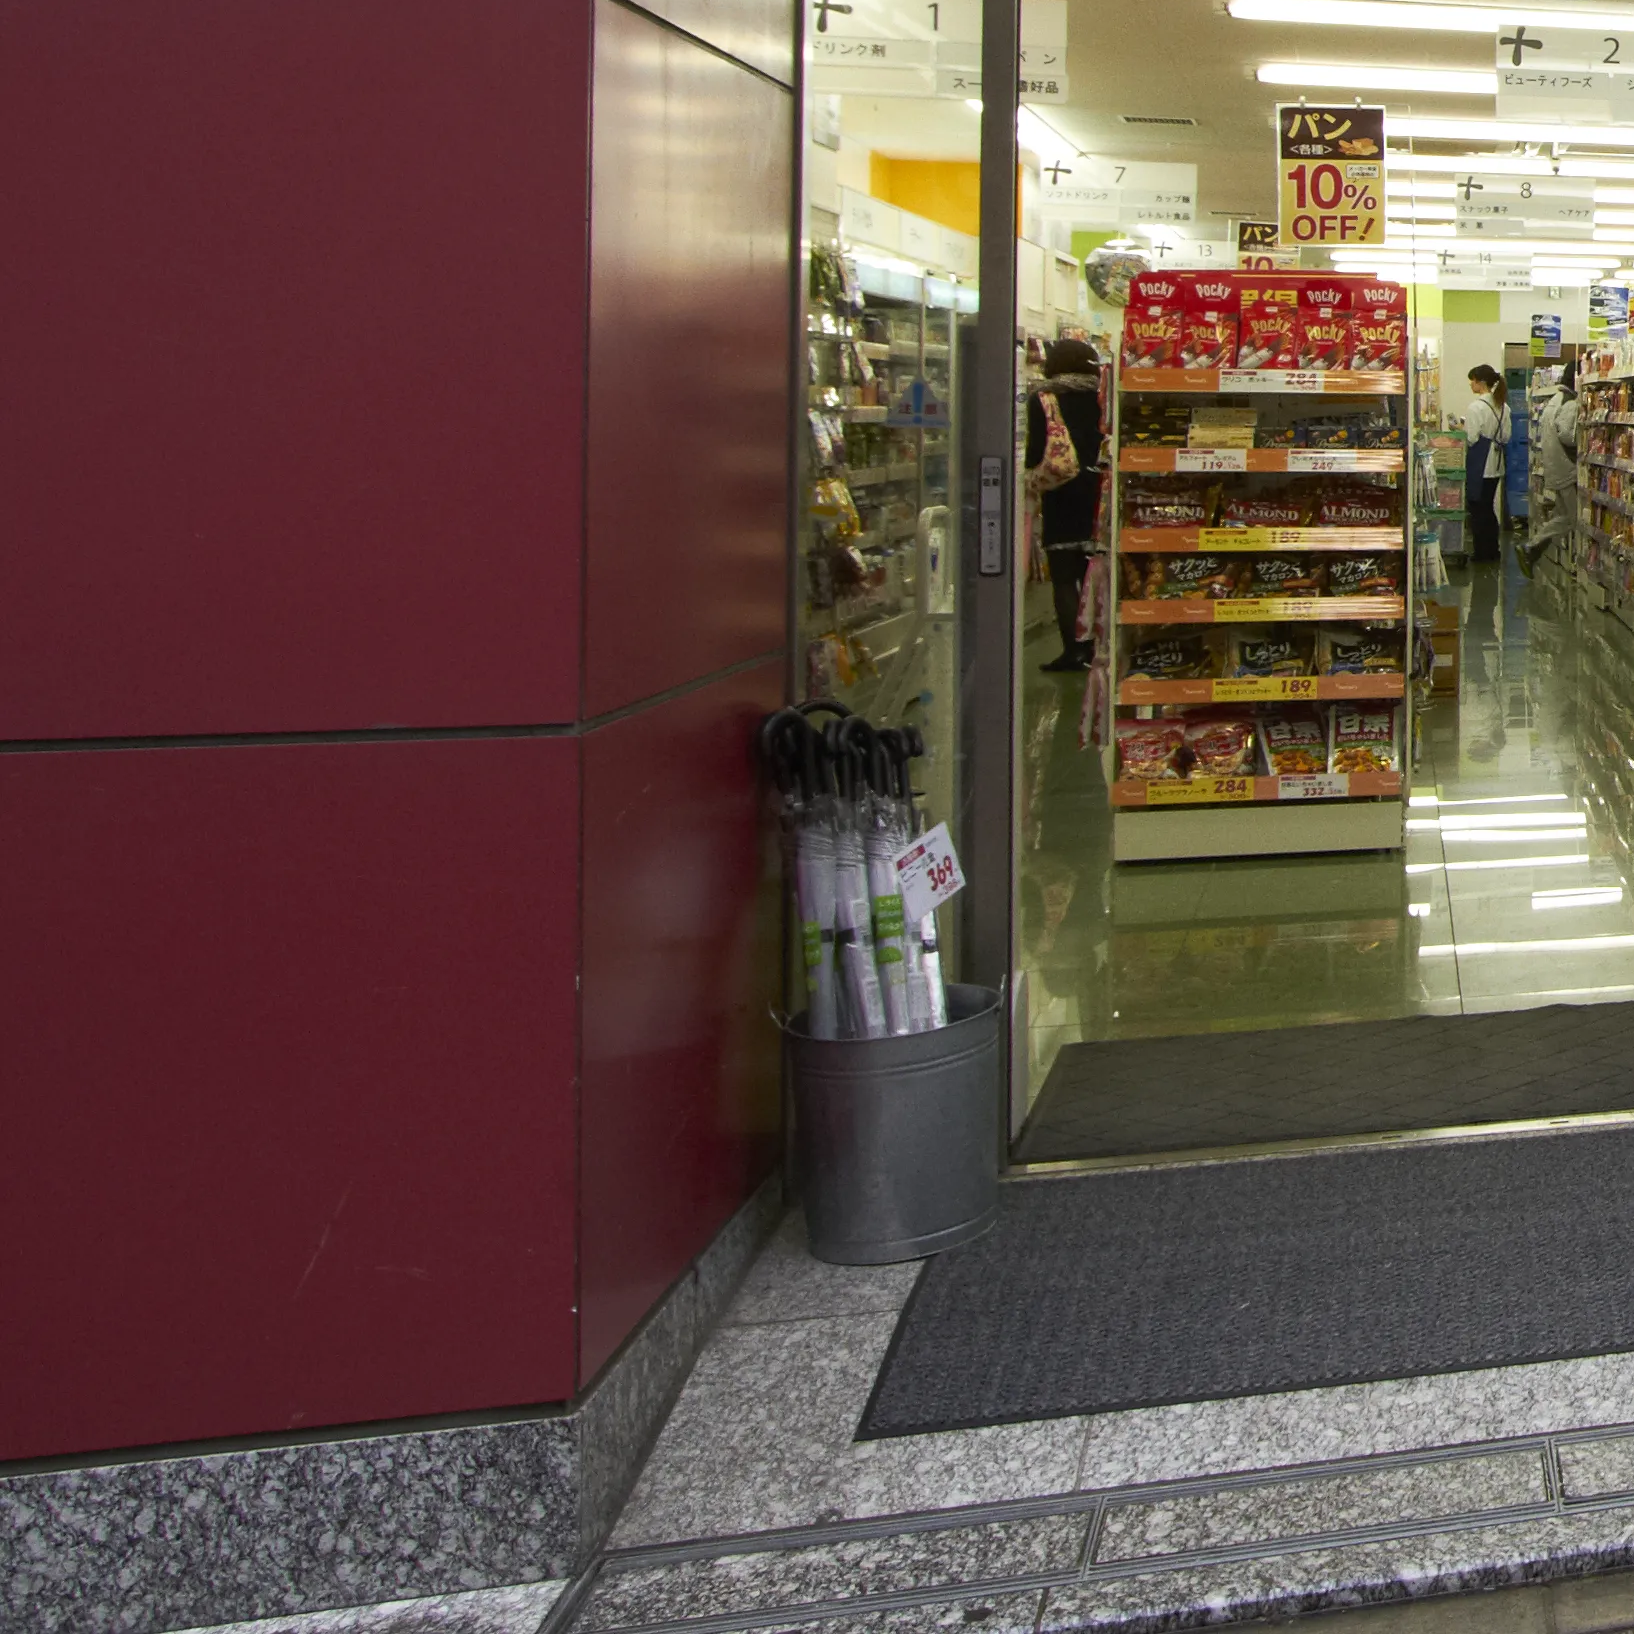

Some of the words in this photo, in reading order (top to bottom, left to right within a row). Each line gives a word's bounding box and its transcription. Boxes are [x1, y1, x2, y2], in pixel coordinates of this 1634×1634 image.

[927, 2, 940, 31] 1
[813, 43, 886, 58] リンク剤
[1602, 37, 1620, 64] 2
[1504, 74, 1592, 88] ビューティフーズ
[1287, 113, 1352, 141] パン
[1113, 166, 1127, 184] 7
[1287, 163, 1377, 211] 10%
[1520, 181, 1532, 199] 8
[1292, 214, 1375, 241] OFF!
[1201, 461, 1223, 470] 119
[1226, 502, 1299, 521] ALMOND
[1320, 504, 1390, 519] ALMOND
[1281, 679, 1312, 694] 189
[1213, 779, 1248, 794] 284
[927, 854, 953, 892] 369
